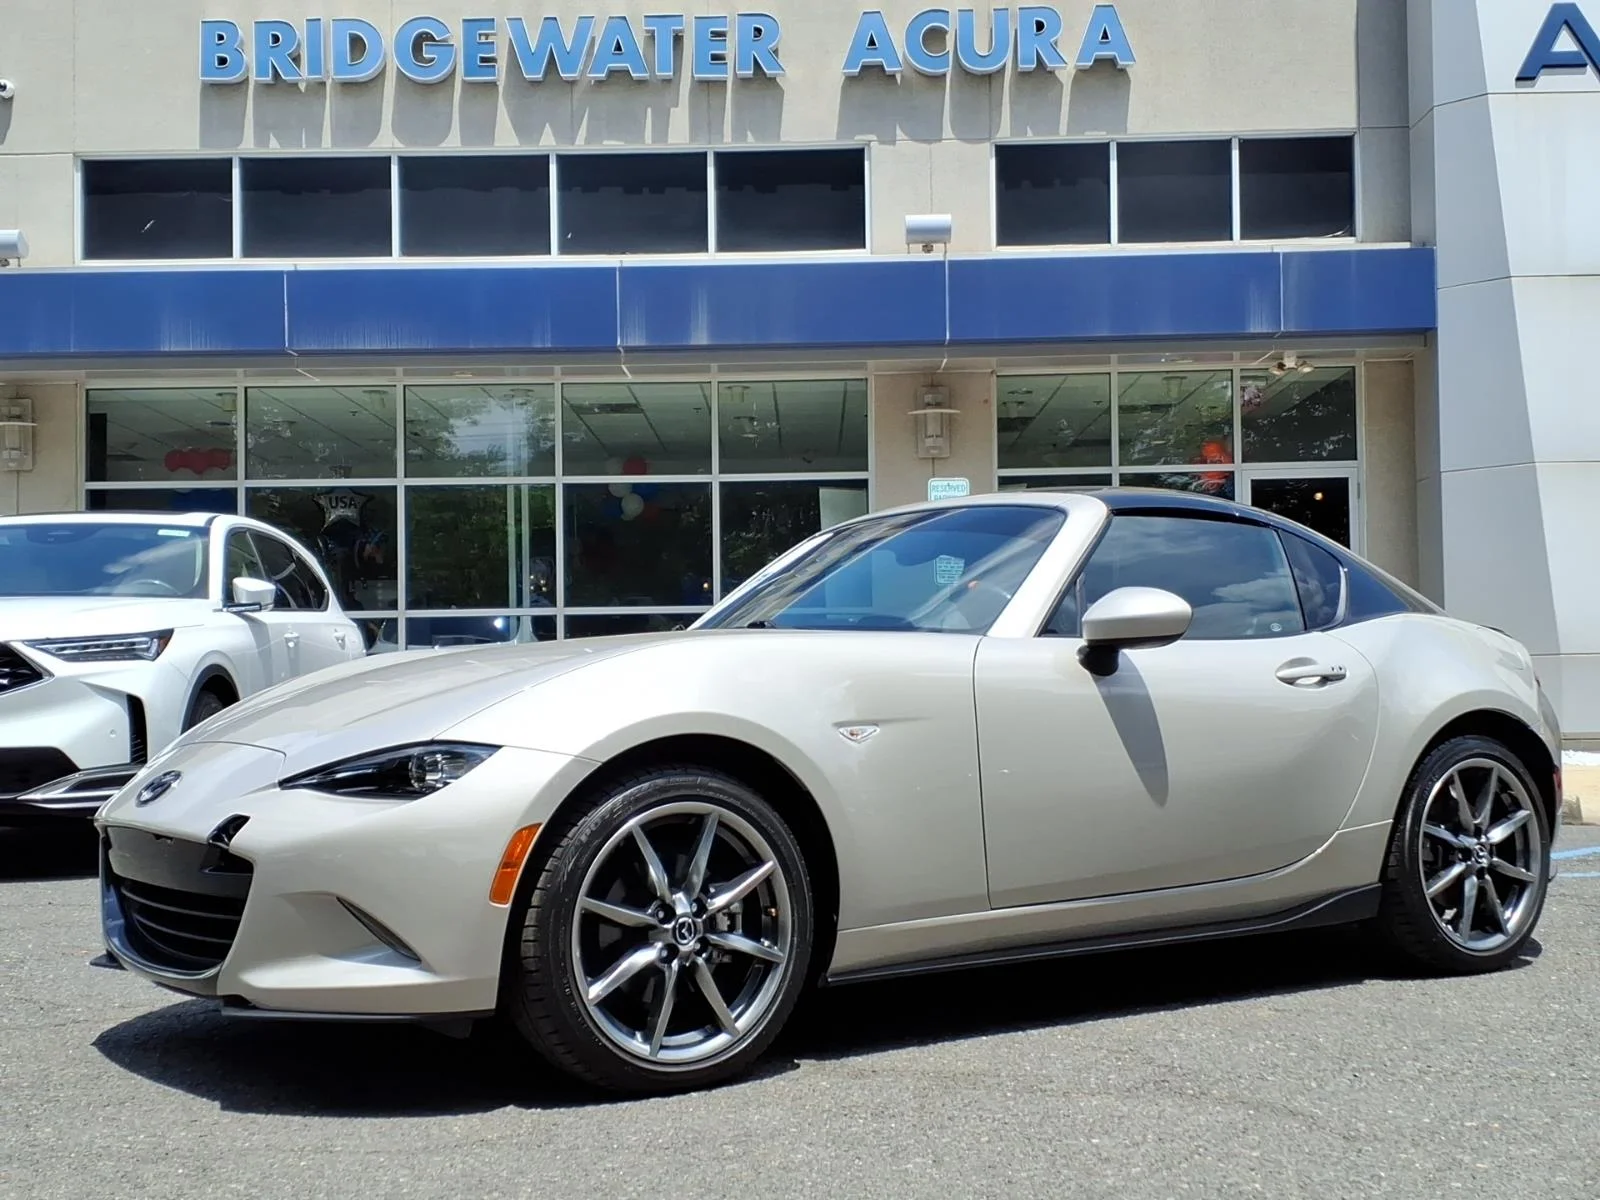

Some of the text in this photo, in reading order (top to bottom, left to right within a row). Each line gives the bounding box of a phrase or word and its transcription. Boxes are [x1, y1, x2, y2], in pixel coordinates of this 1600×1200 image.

[200, 4, 1137, 84] BRIDGEWATER ACURA
[932, 484, 966, 492] RESERVED
[329, 496, 358, 509] USA
